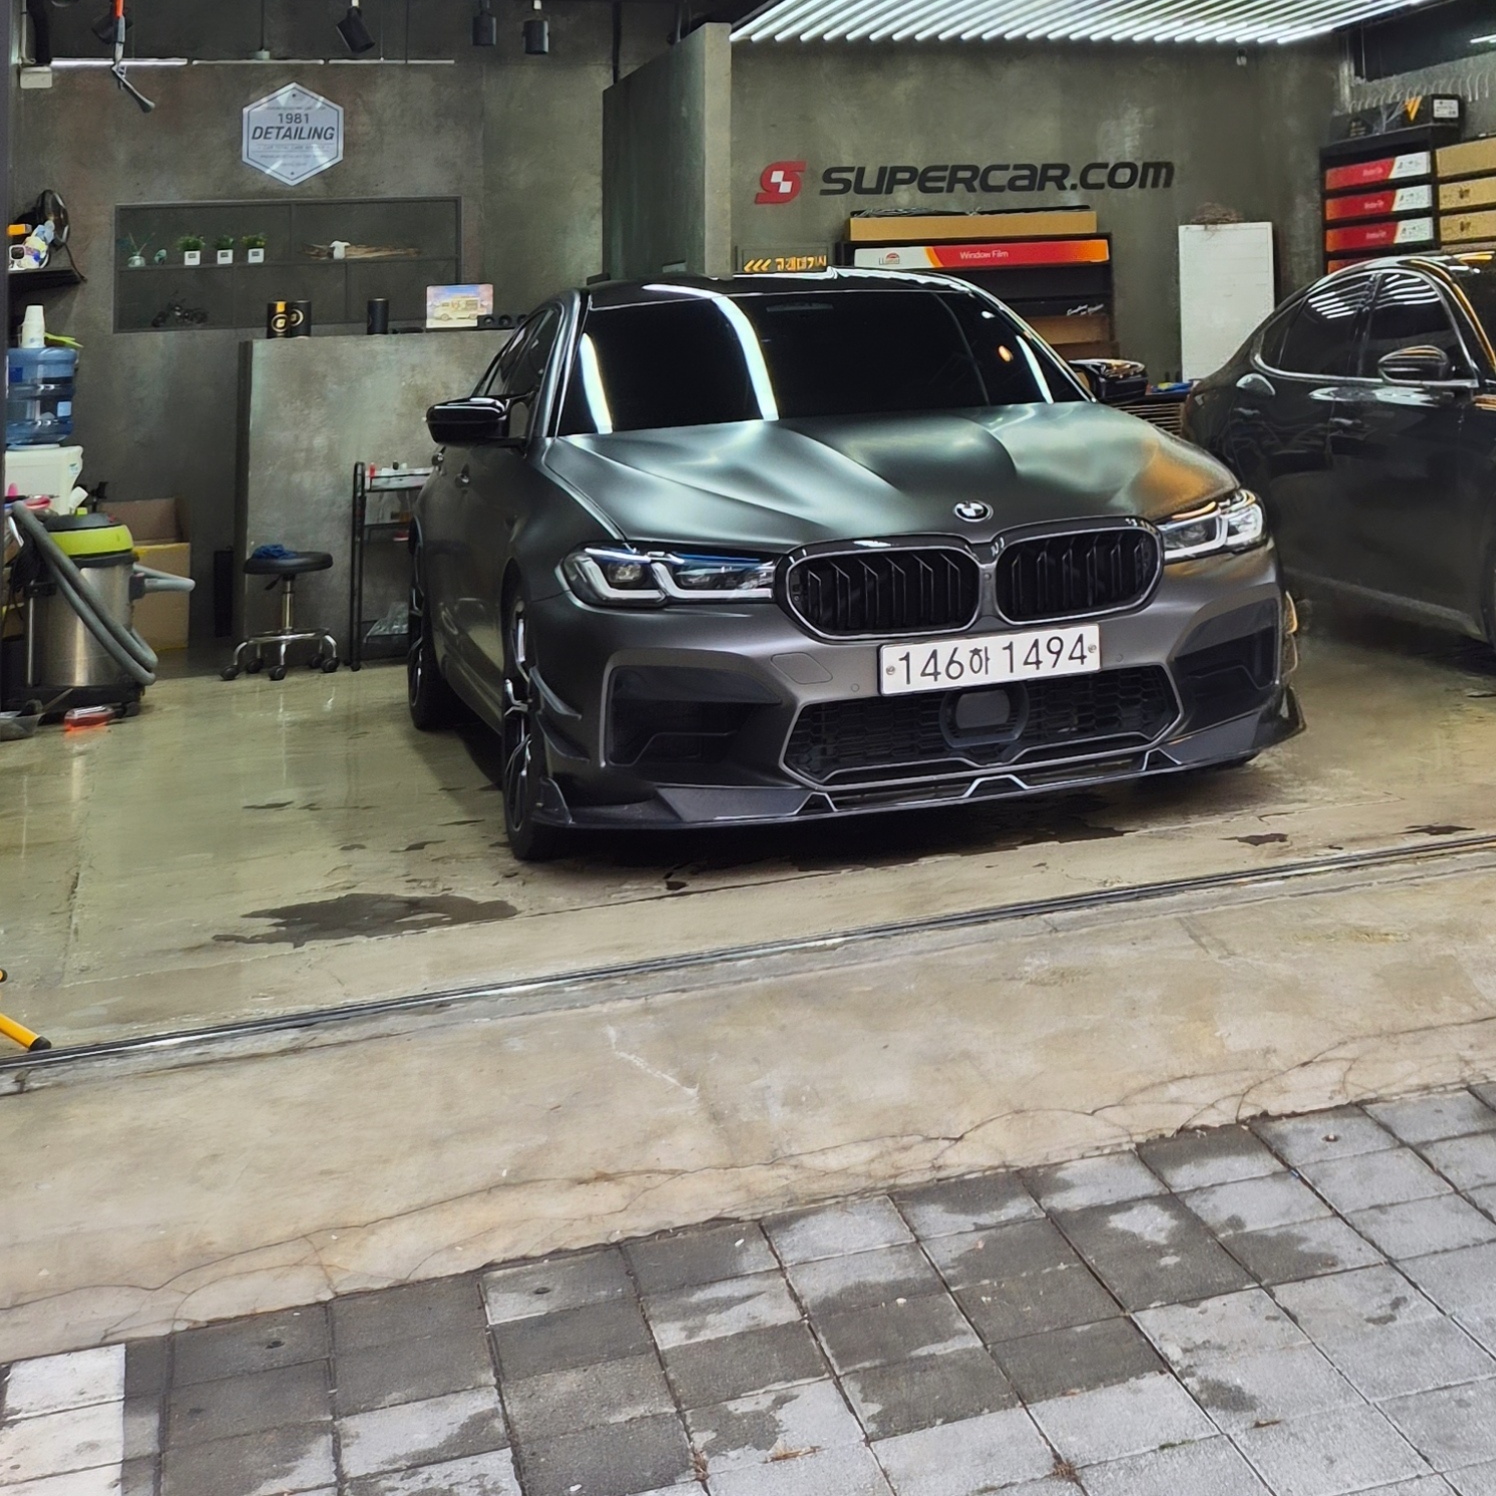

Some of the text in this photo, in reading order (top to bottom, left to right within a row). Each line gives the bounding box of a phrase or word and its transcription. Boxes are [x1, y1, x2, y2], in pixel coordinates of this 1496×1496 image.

[278, 113, 310, 124] 1981
[251, 126, 336, 140] DETAILING
[959, 249, 1009, 260] Window Film
[898, 633, 1088, 685] 146하 1494
